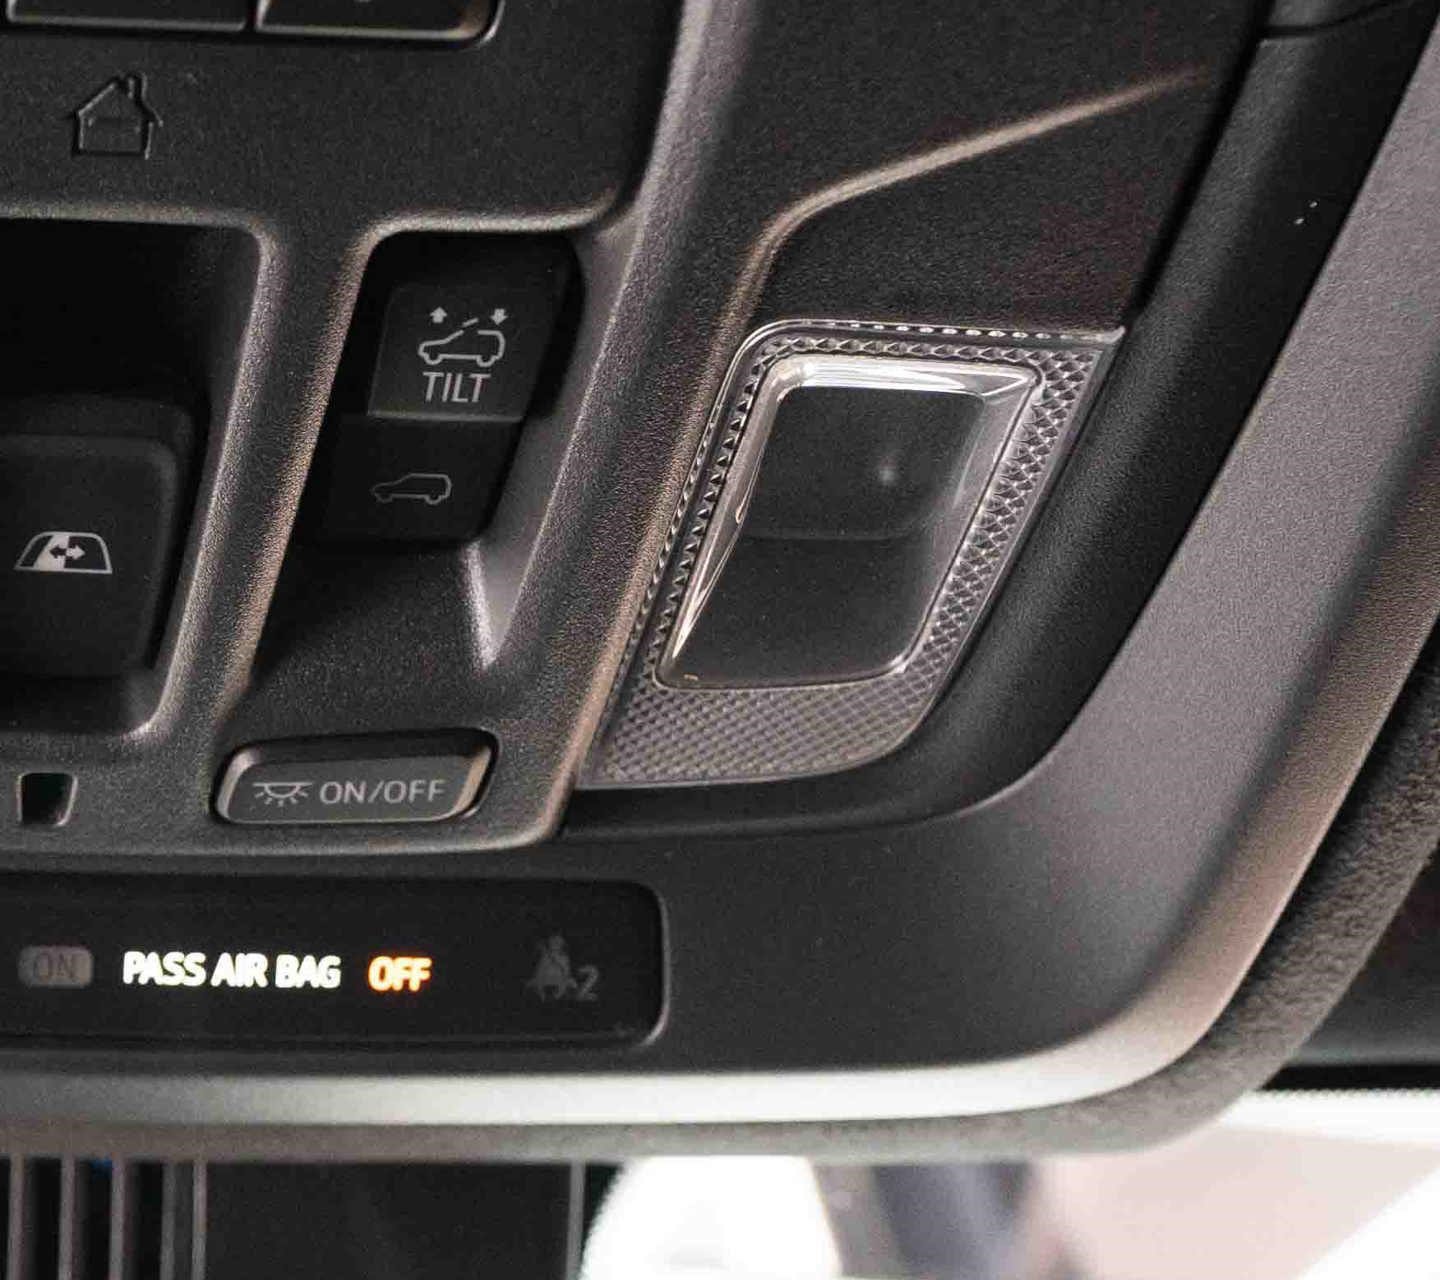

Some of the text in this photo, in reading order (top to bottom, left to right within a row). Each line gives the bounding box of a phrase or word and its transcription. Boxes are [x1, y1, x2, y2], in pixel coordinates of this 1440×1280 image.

[422, 372, 490, 403] TILT
[319, 779, 446, 806] ON/OFF
[33, 954, 77, 980] ON
[122, 951, 432, 991] PASS AIR BAG OFF
